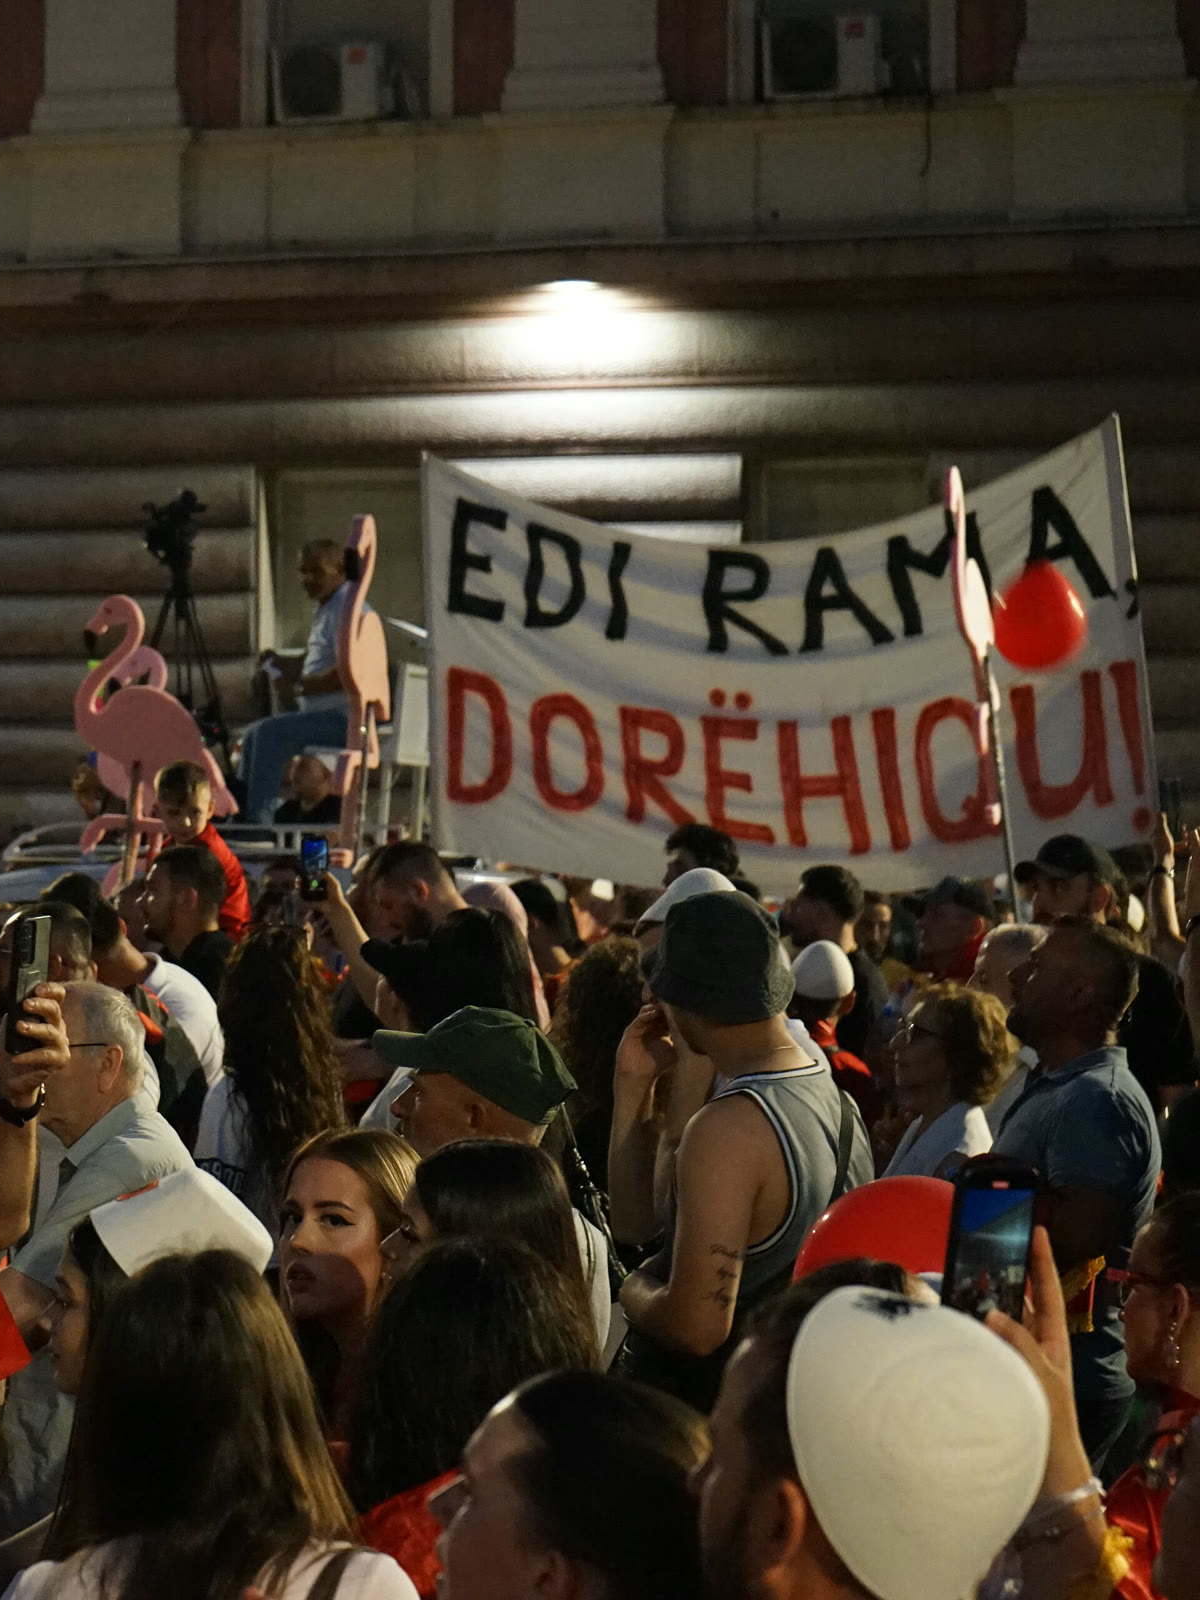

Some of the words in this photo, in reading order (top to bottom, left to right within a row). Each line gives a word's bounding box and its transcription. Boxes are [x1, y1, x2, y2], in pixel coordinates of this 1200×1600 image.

[447, 497, 632, 641] EDI
[702, 485, 1140, 656] RAMA,
[446, 659, 1148, 856] DORËHIQU!
